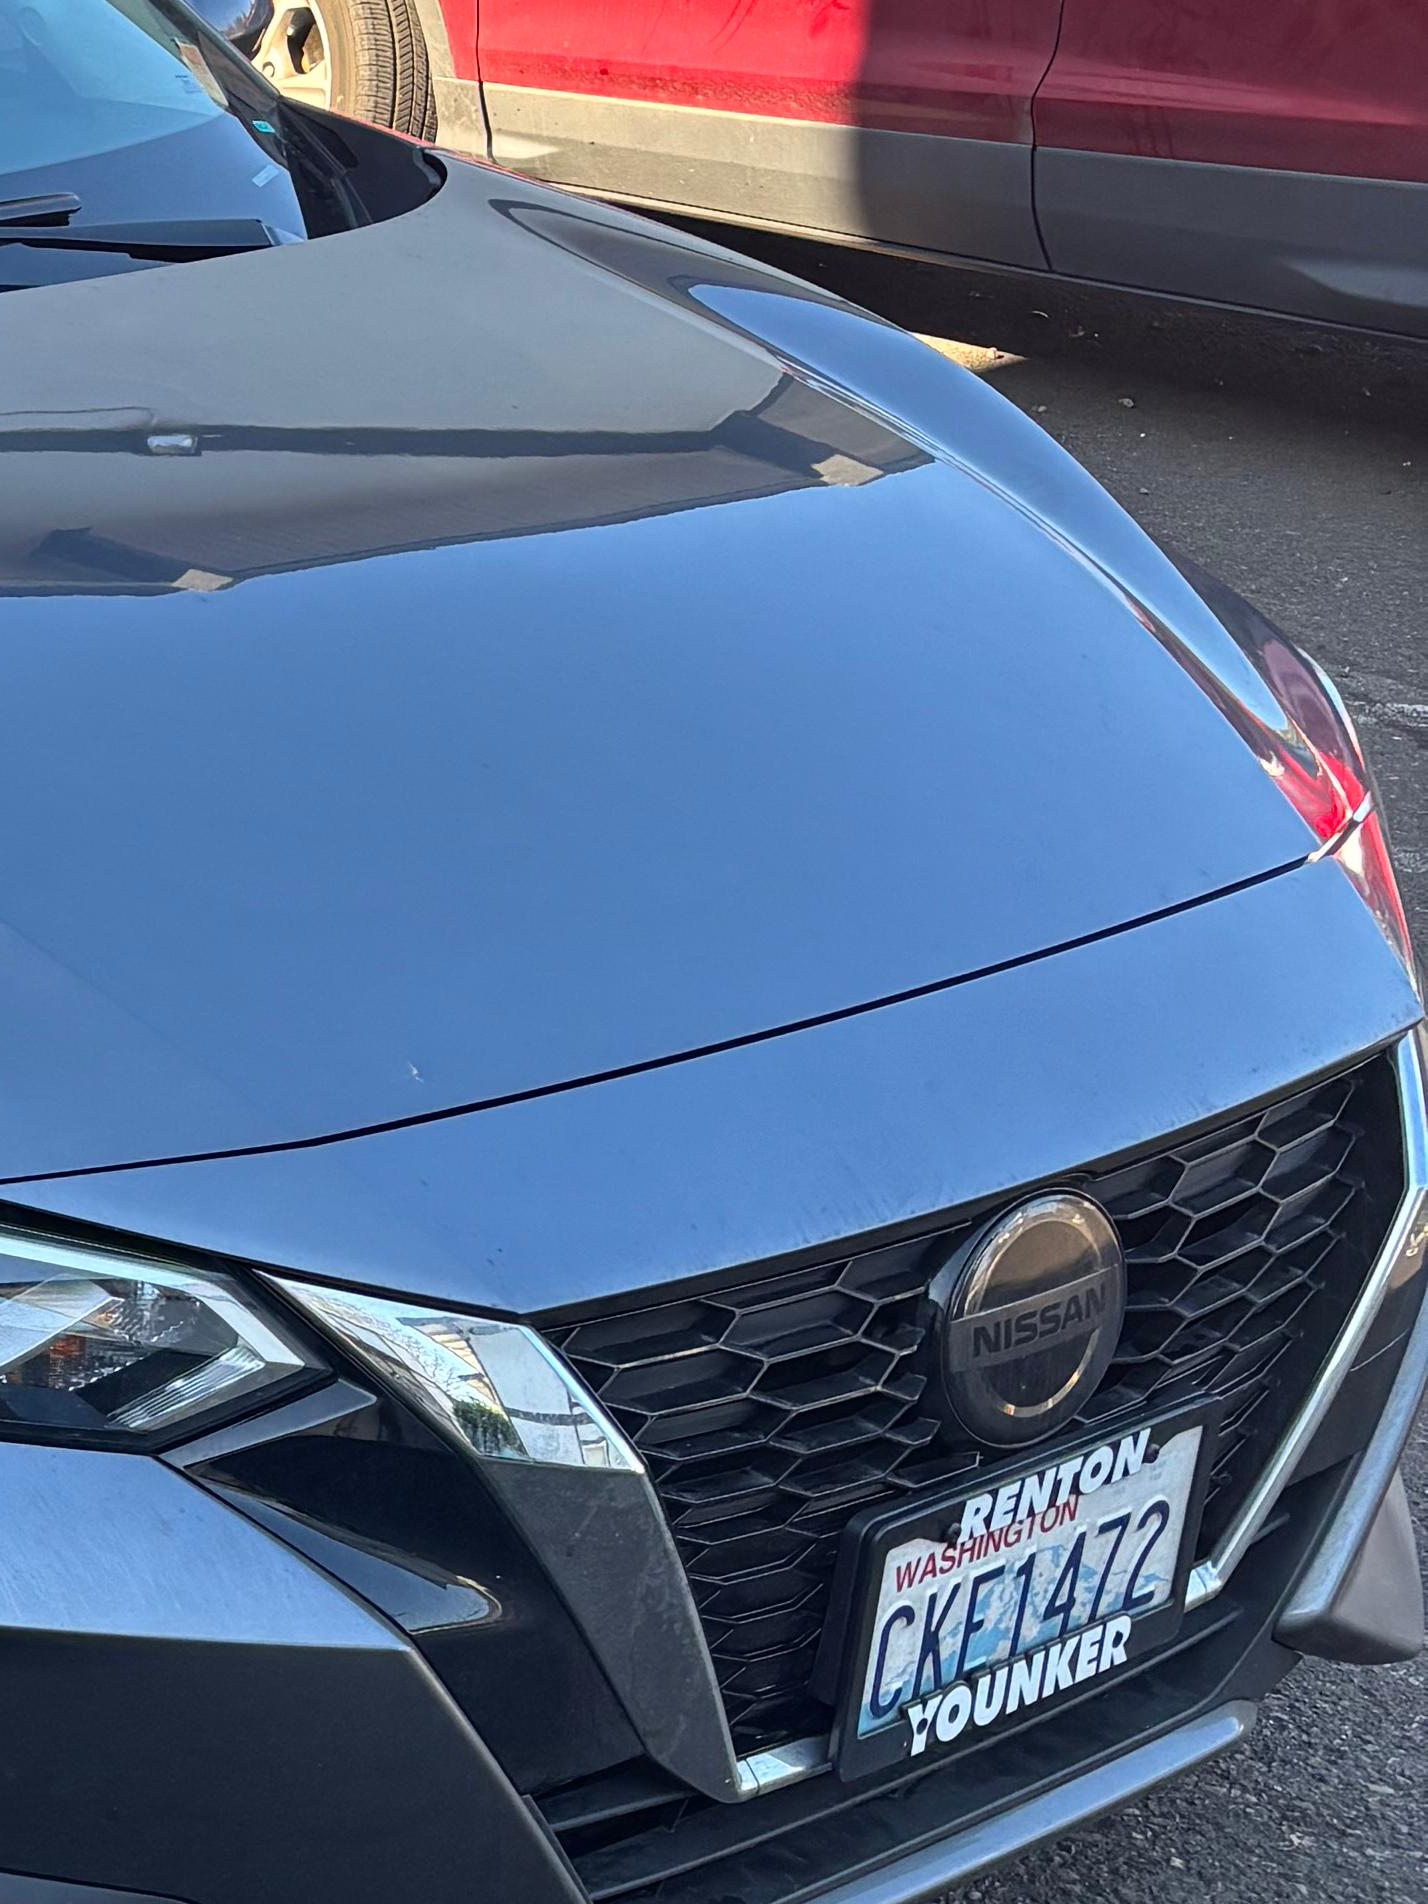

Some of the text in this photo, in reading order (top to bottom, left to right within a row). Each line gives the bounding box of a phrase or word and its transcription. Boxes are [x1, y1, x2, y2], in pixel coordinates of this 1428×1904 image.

[972, 1282, 1107, 1358] NISSAN
[957, 1427, 1153, 1544] RENTON
[894, 1492, 1081, 1594] WASHINGTON
[906, 1614, 1133, 1757] YOUNKER
